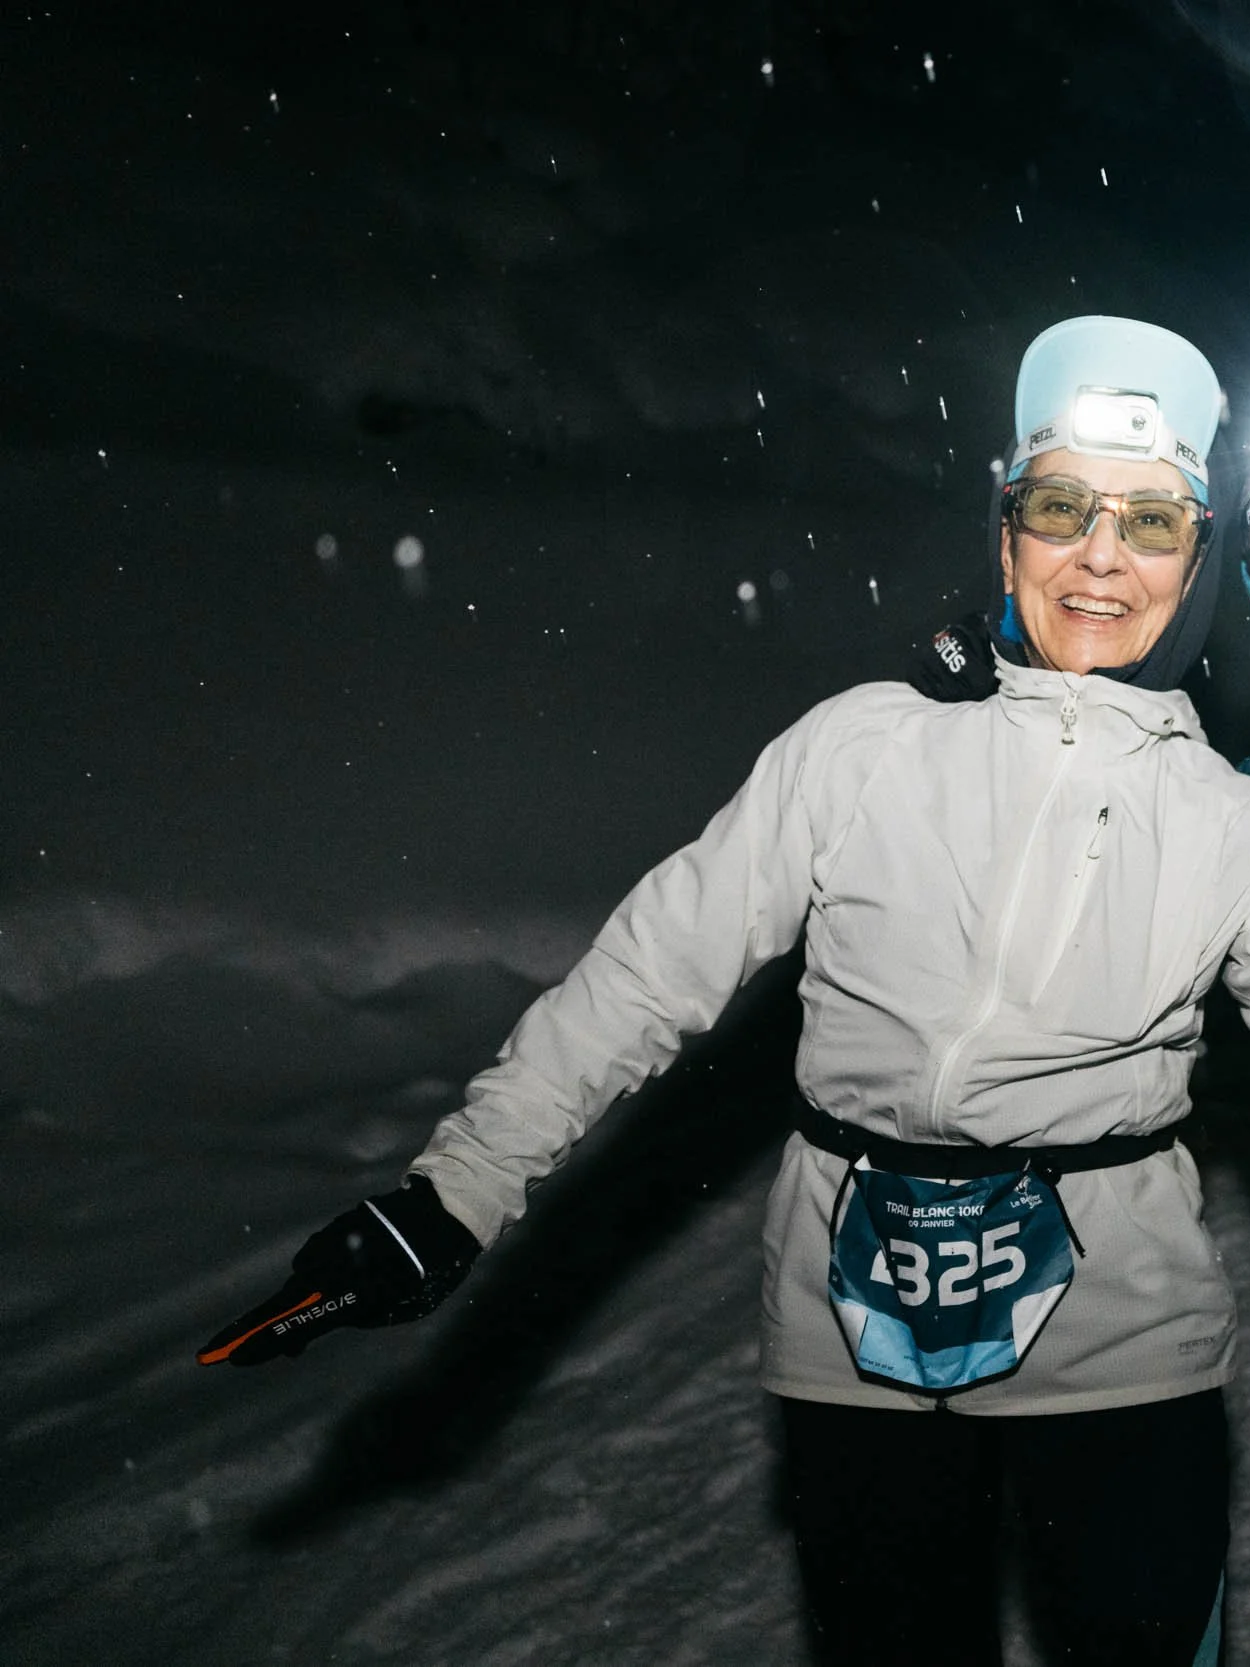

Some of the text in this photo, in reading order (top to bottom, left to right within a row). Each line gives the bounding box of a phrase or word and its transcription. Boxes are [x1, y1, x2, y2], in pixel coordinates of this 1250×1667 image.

[1030, 427, 1056, 450] PETZL
[1176, 441, 1200, 468] PETZL
[886, 1201, 910, 1217] TRAIL
[912, 1206, 955, 1218] BLANC
[908, 1219, 955, 1228] 09 JANVIER
